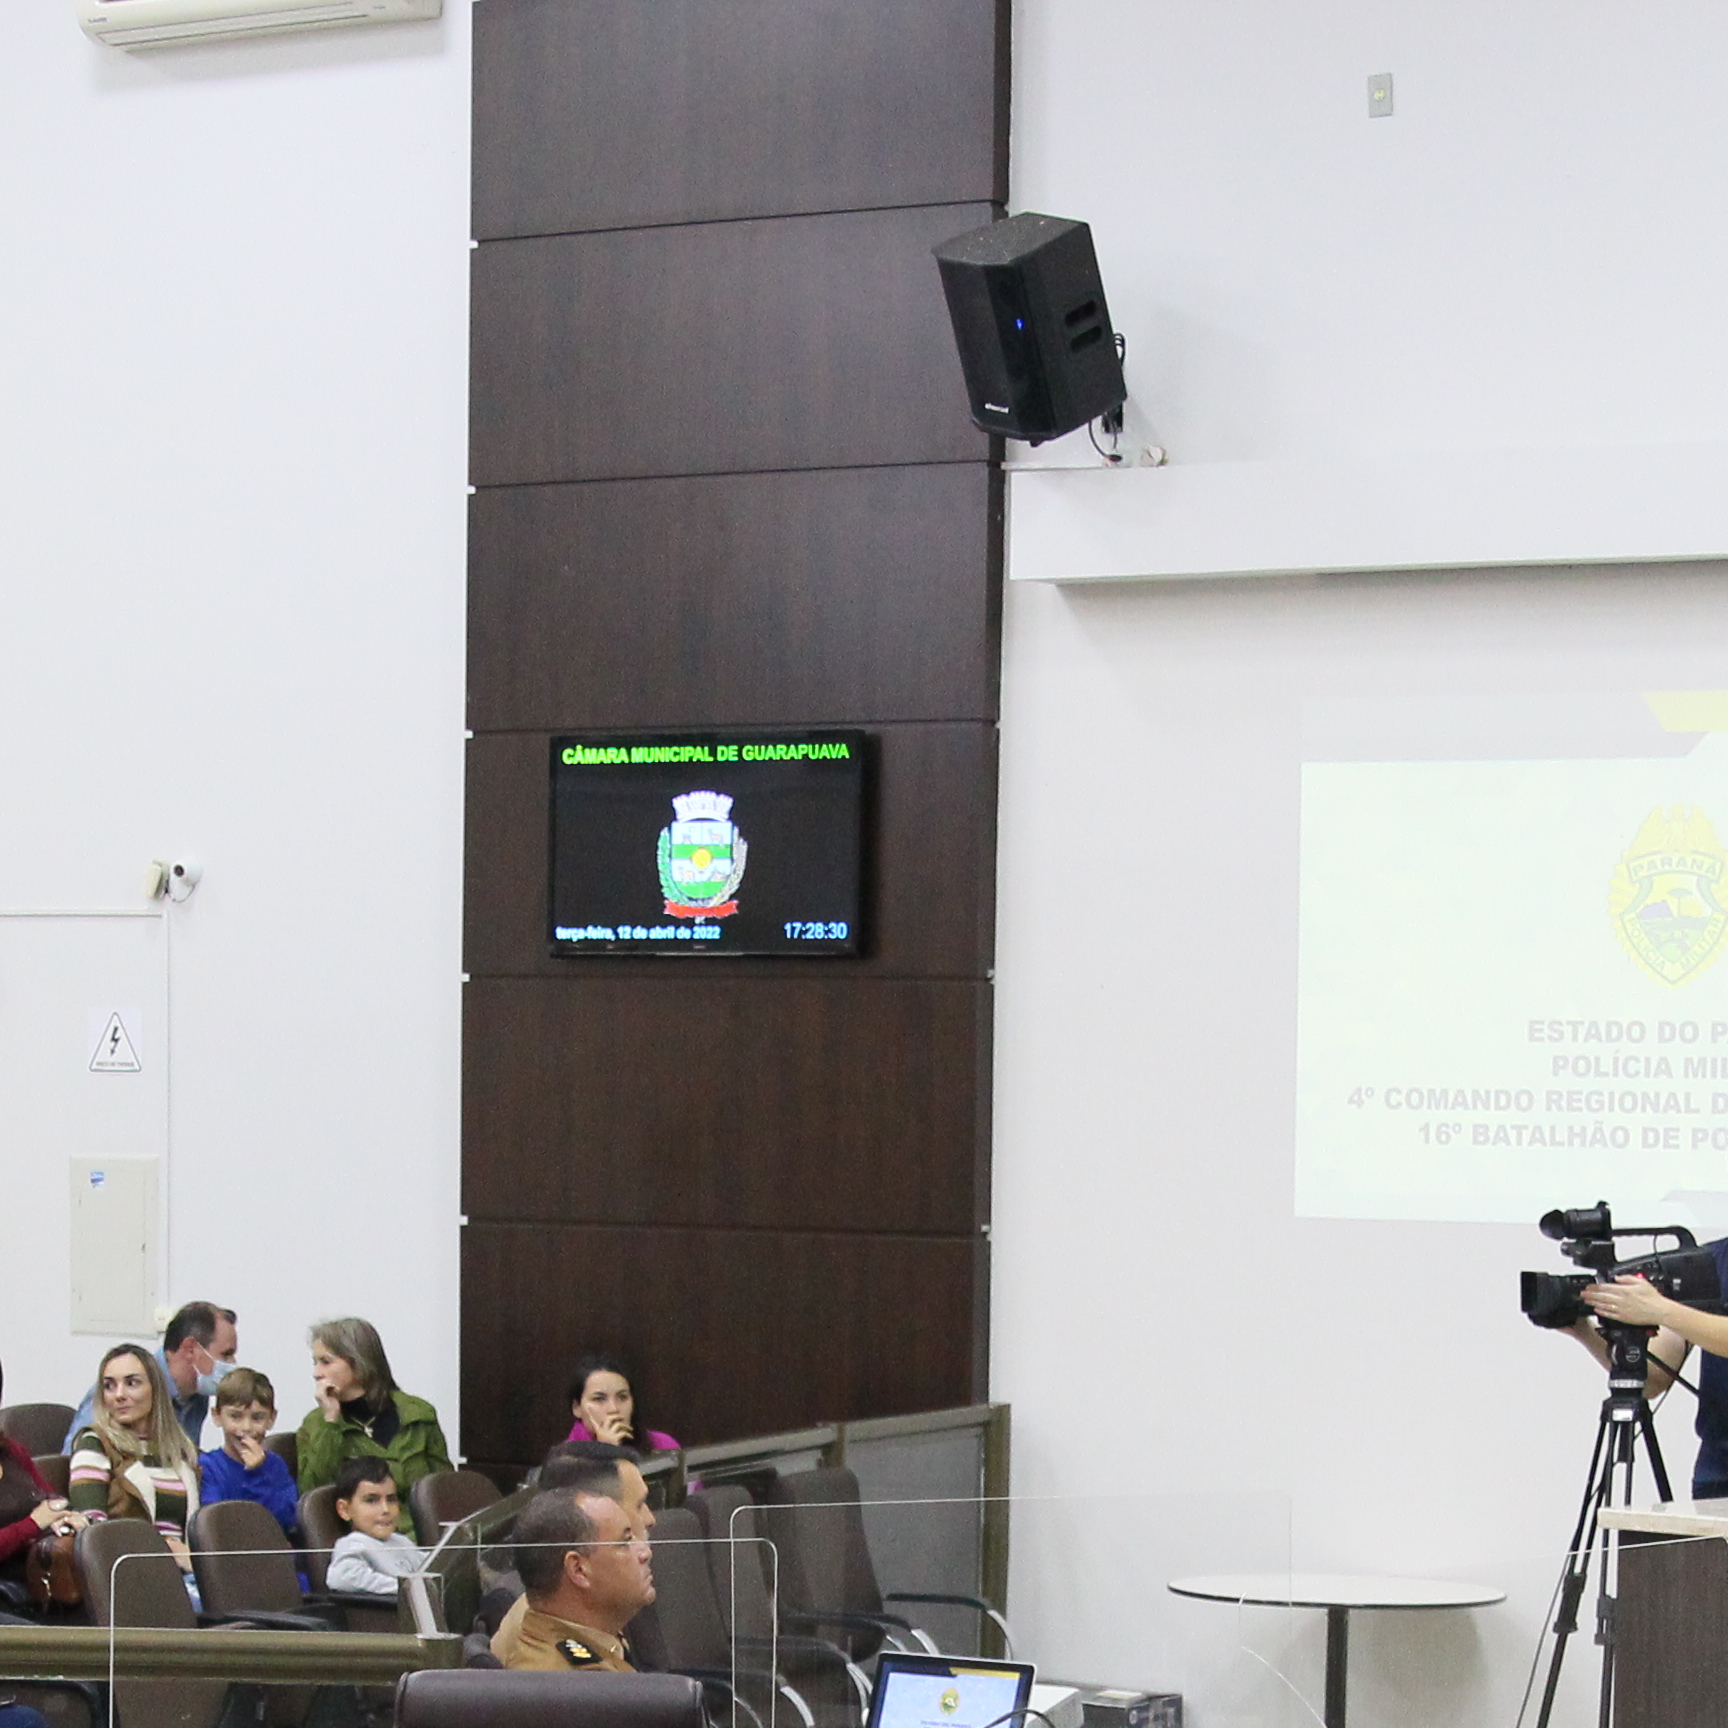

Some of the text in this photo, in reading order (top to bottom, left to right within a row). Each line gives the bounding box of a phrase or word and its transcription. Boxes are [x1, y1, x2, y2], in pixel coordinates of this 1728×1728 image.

[562, 743, 850, 764] CÂMARA MUNICIPAL DE GUARAPUAVA
[1632, 854, 1716, 876] PARANÁ
[617, 926, 631, 939] 12
[632, 926, 648, 939] de
[649, 926, 675, 939] abril
[676, 926, 691, 939] de
[692, 926, 721, 940] 2022
[783, 921, 848, 940] 17:28:30
[1528, 1019, 1647, 1044] ESTADO
[1658, 1020, 1700, 1044] DO
[1552, 1050, 1674, 1079] POLÍCIA
[1384, 1087, 1534, 1113] COMANDO
[1546, 1090, 1700, 1114] REGIONAL
[1472, 1120, 1631, 1150] BATALHÃO
[1642, 1126, 1680, 1150] DE
